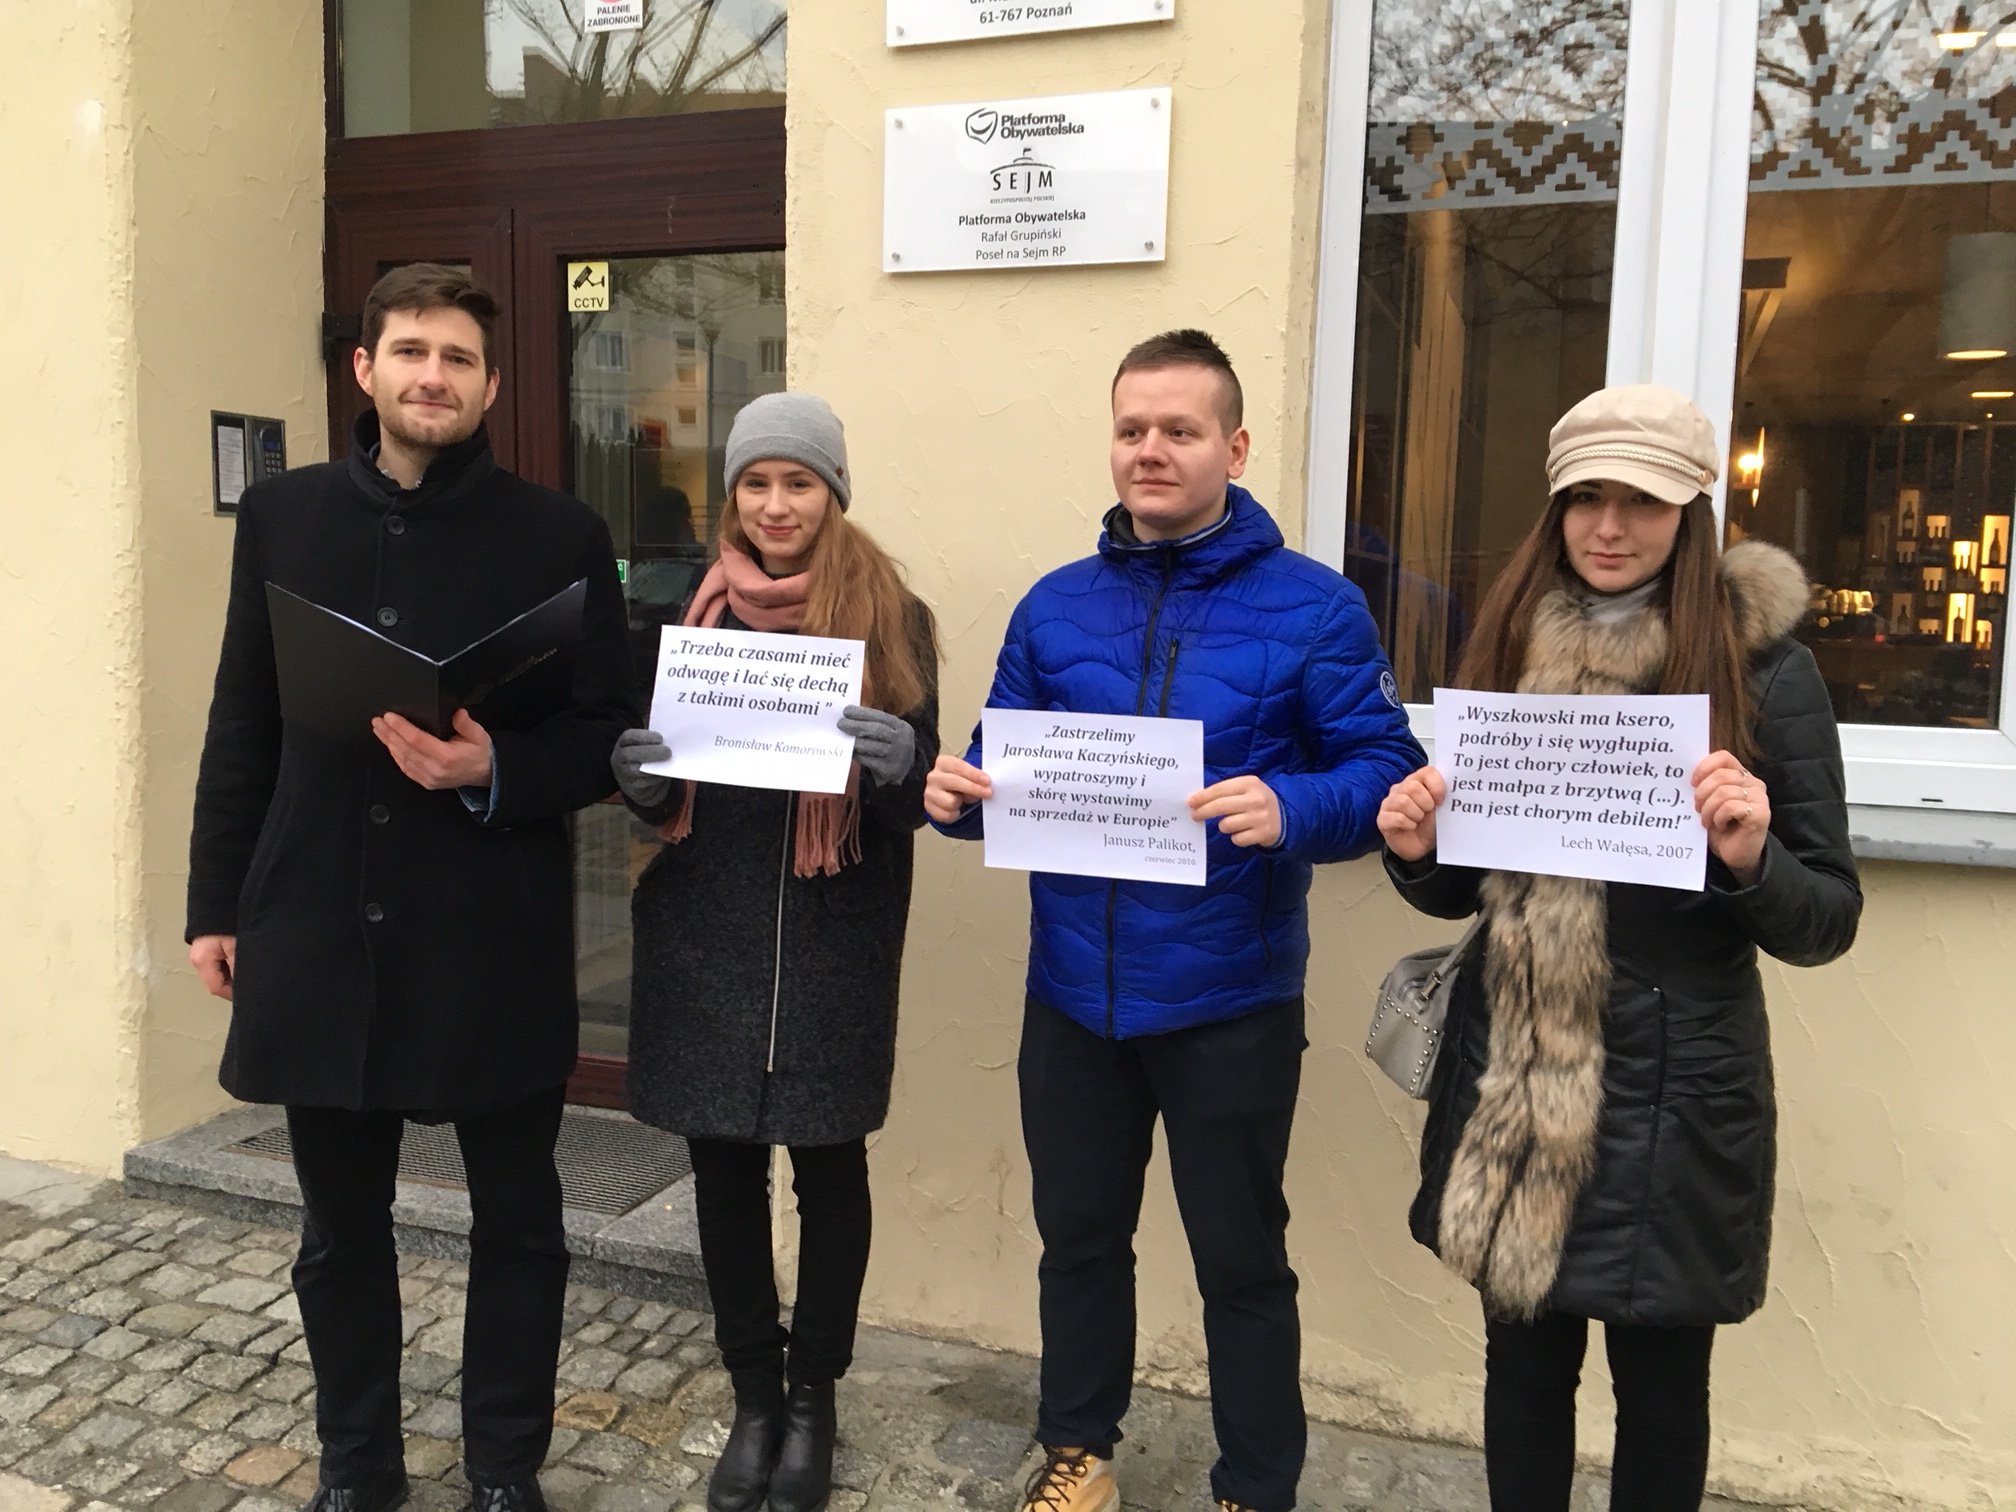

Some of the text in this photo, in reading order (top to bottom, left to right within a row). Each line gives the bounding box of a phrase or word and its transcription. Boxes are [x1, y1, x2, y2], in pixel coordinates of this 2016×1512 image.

[597, 5, 630, 15] PALENIE
[980, 2, 1072, 24] 61-767 Poznań
[588, 15, 640, 27] ZABRONIONE
[1001, 113, 1065, 126] Platforma
[1001, 123, 1084, 140] Obywatelska
[992, 171, 1052, 193] SEJM
[959, 210, 1086, 226] Platforma Obywatelska
[981, 229, 1061, 243] Rafał Grupiński
[976, 247, 1066, 260] Poseł na Sejm RP
[575, 298, 604, 308] CCTV
[671, 640, 851, 668] „Trzeba czasami mieć
[668, 665, 848, 696] odwagę i lać się dechą
[678, 693, 686, 702] z
[691, 693, 745, 708] takimi
[749, 698, 820, 715] osobami
[1458, 706, 1675, 729] „Wyszkowski ma ksero,
[715, 736, 772, 751] Bronisław
[1045, 726, 1135, 745] „Zastrzelimy
[1459, 730, 1674, 755] podróby i się wygłupia.
[1002, 744, 1179, 769] Jarosława Kaczyńskiego,
[1454, 753, 1684, 778] To jest chory człowiek, to
[1034, 769, 1146, 787] wypatroszymy i
[1028, 788, 1152, 809] skórę wystawimy
[1451, 776, 1483, 792] jest
[1488, 781, 1545, 797] małpa
[1551, 785, 1559, 795] z
[1565, 783, 1642, 803] brzytwą
[1009, 806, 1026, 817] na
[1030, 809, 1093, 823] sprzedaż
[1097, 815, 1109, 824] w
[1450, 799, 1483, 814] Pan
[1487, 801, 1520, 817] jest
[1524, 806, 1591, 825] chorym
[1103, 834, 1196, 852] Janusz Palikot,
[1561, 836, 1693, 859] Lech Wałęsa, 2007
